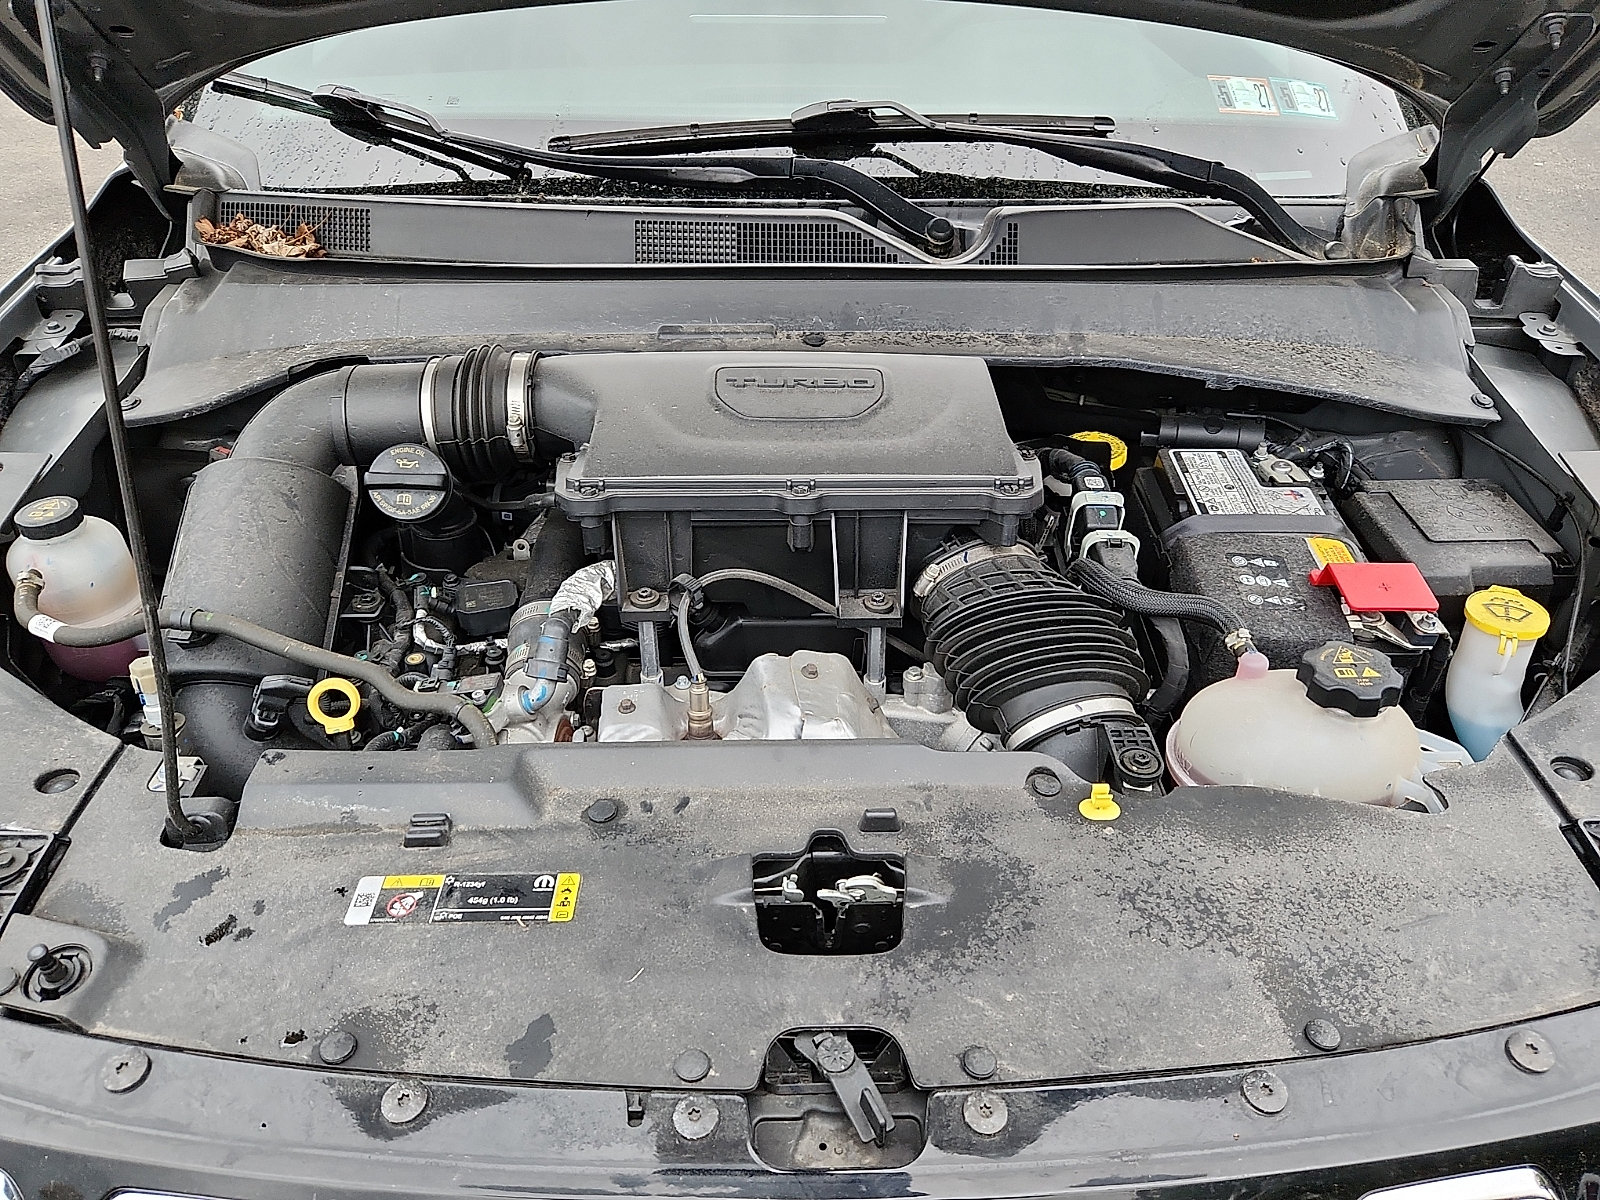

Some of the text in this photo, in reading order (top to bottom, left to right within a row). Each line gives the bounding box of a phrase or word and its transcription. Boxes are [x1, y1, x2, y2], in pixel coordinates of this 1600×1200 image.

[1253, 83, 1271, 110] 27
[1313, 87, 1330, 112] 27
[726, 376, 876, 389] TURBO
[390, 447, 426, 457] ENGINE OIL
[467, 896, 489, 905] 454g
